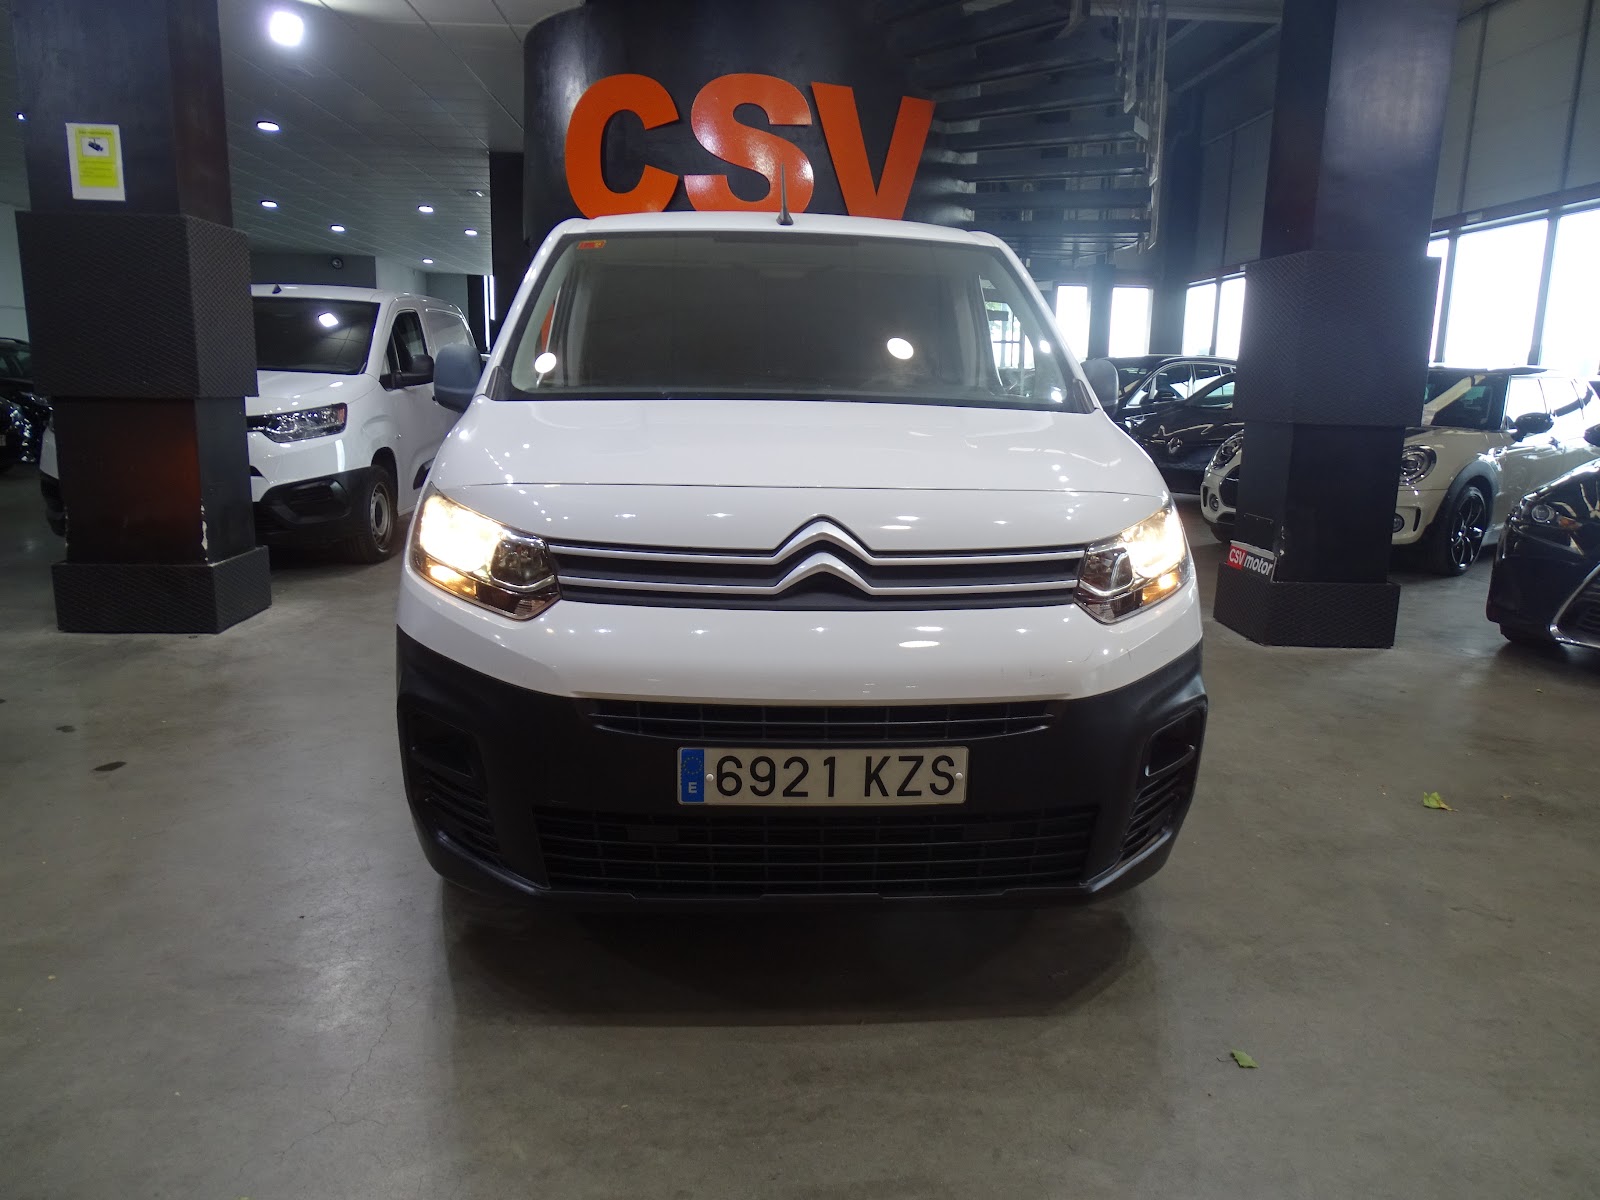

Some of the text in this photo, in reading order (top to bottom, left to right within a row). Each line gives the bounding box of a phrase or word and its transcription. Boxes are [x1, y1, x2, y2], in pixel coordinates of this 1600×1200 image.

[565, 73, 936, 220] CSV
[1229, 548, 1273, 576] CSV motor
[688, 782, 698, 793] E
[716, 755, 955, 798] 6921 KZS
